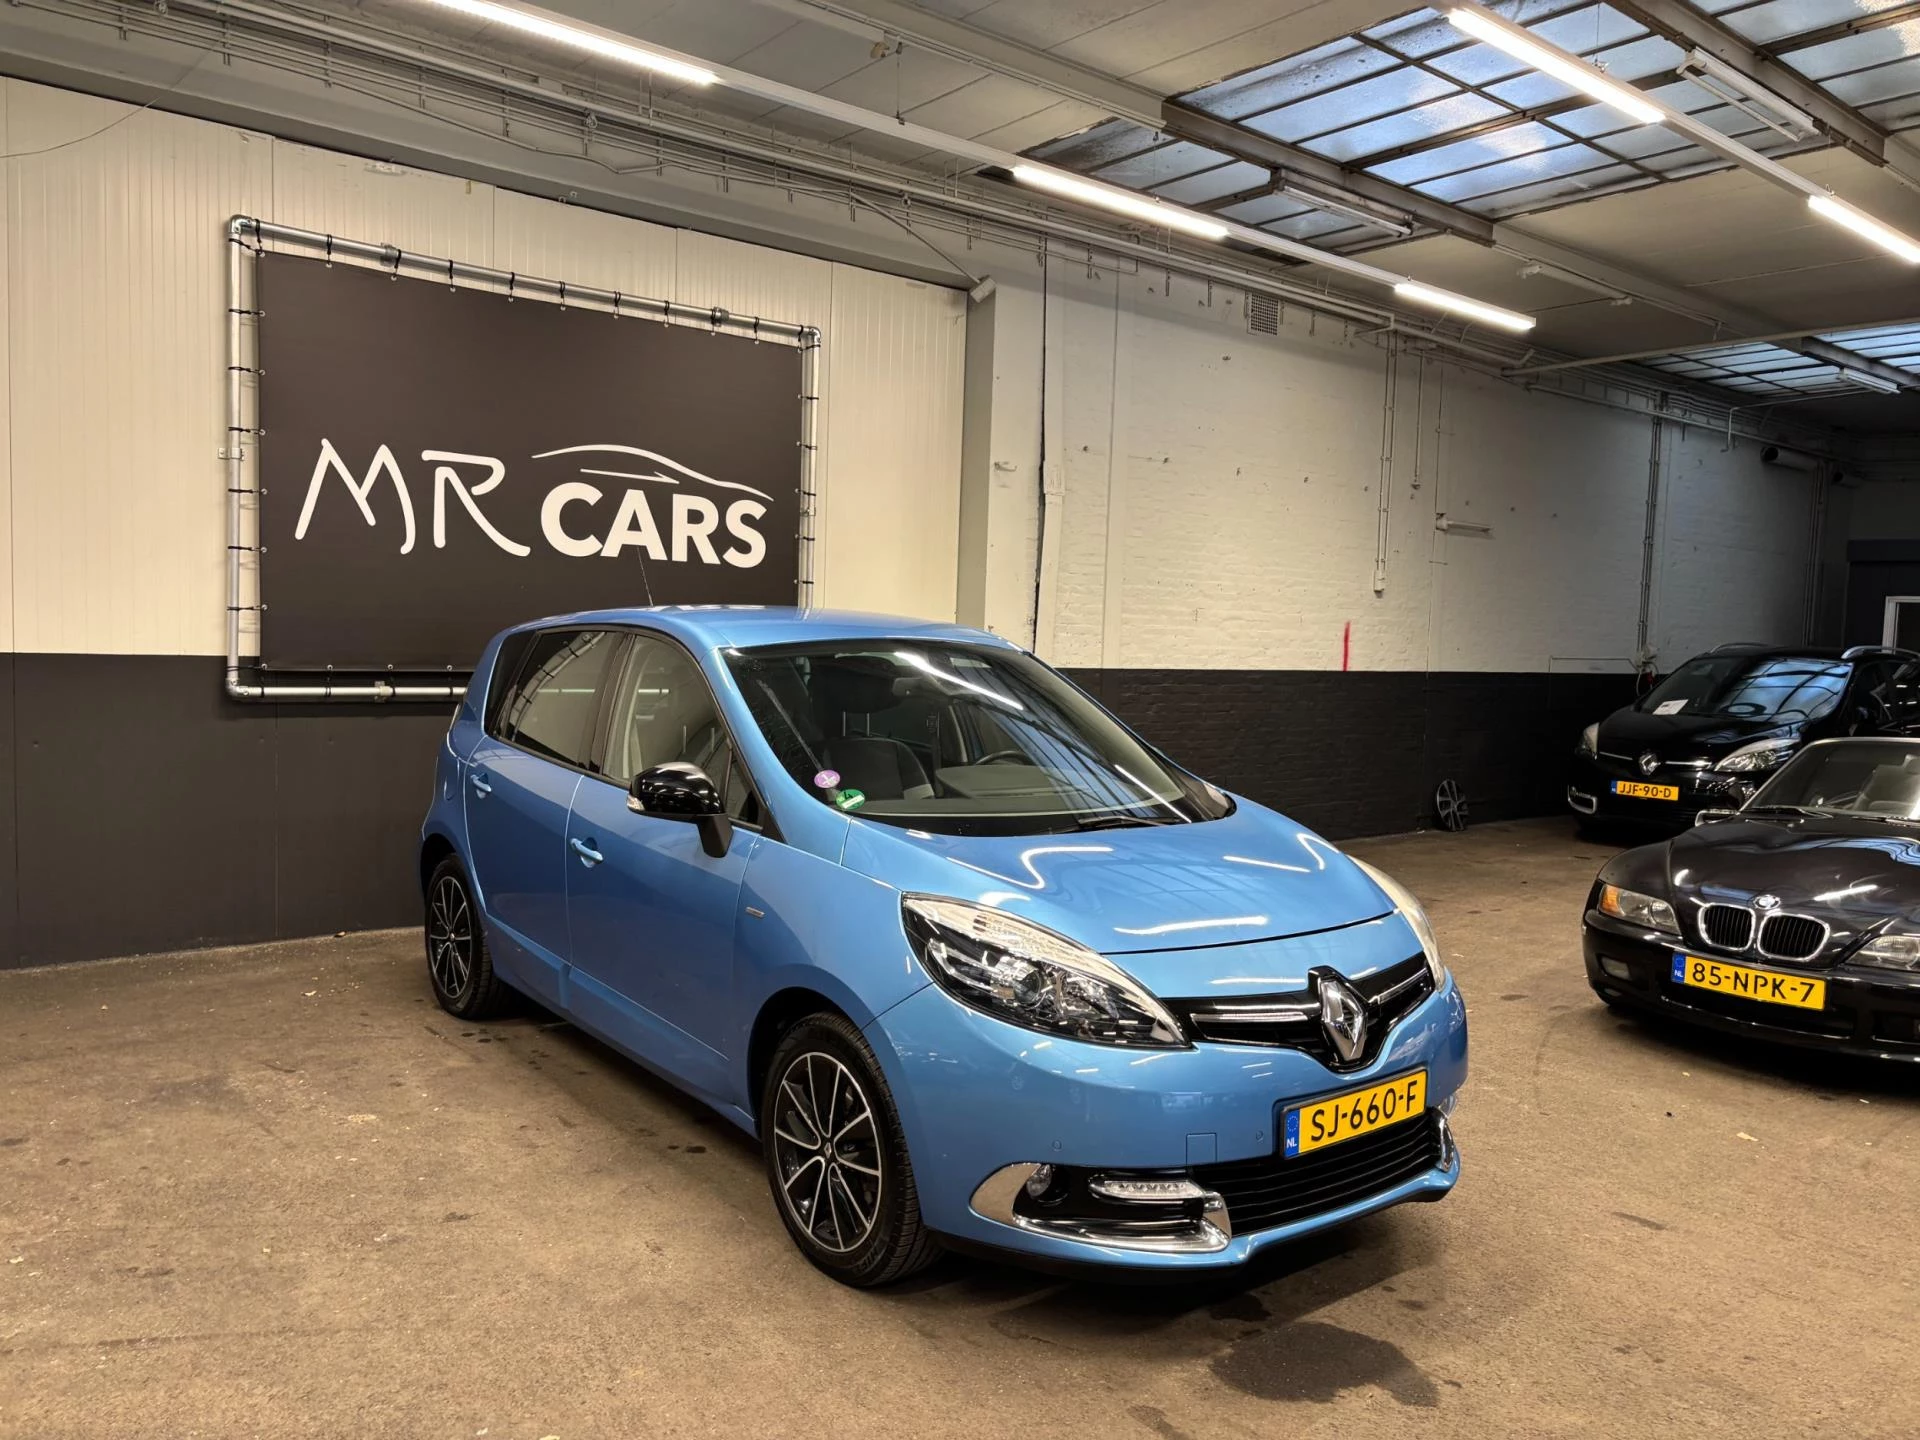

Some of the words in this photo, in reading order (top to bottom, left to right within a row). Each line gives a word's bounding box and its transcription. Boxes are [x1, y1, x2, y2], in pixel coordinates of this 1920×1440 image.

[295, 438, 531, 557] MR
[540, 481, 767, 568] CARS
[1619, 783, 1672, 798] JJF-90-D
[1674, 970, 1684, 978] NL
[1692, 962, 1815, 1003] 85-NPK-7
[1311, 1080, 1418, 1142] SJ-660-F
[1286, 1137, 1297, 1149] NL
